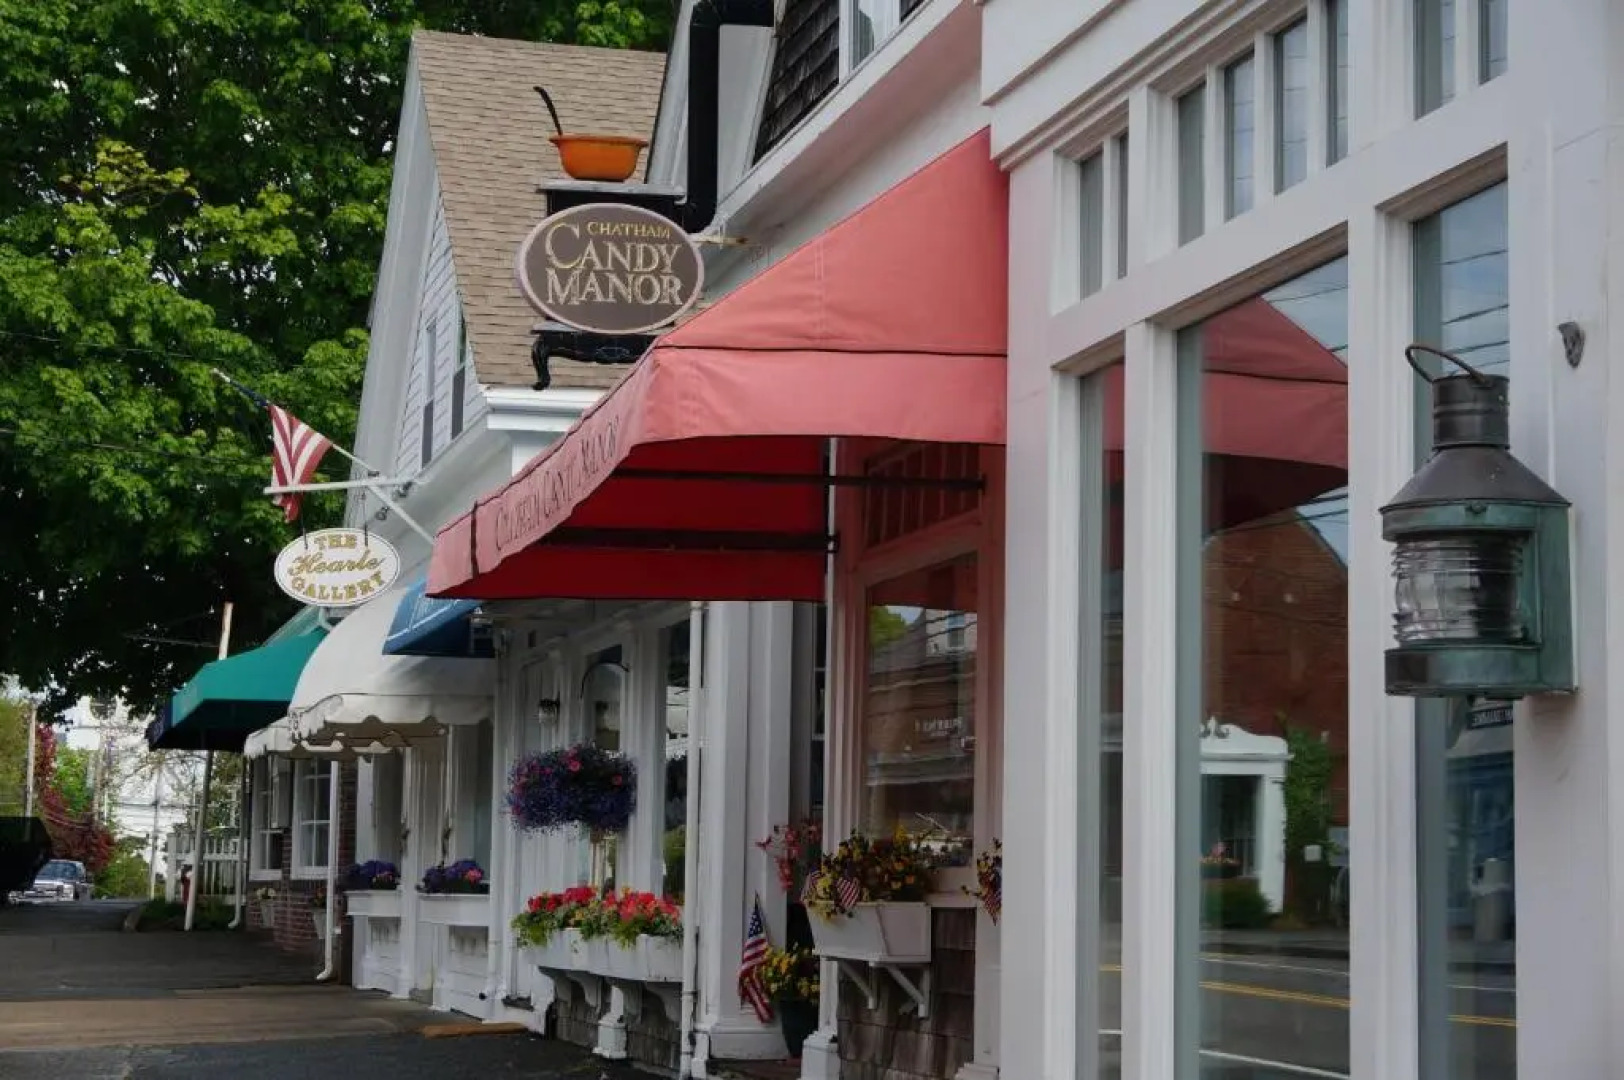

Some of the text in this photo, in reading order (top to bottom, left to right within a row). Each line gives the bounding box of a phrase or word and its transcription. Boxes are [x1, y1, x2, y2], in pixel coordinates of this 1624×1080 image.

[587, 221, 670, 239] CHATHAM
[545, 222, 682, 274] CANDY
[545, 267, 684, 305] MANOR
[314, 534, 358, 550] THE
[291, 570, 384, 600] GALLERY
